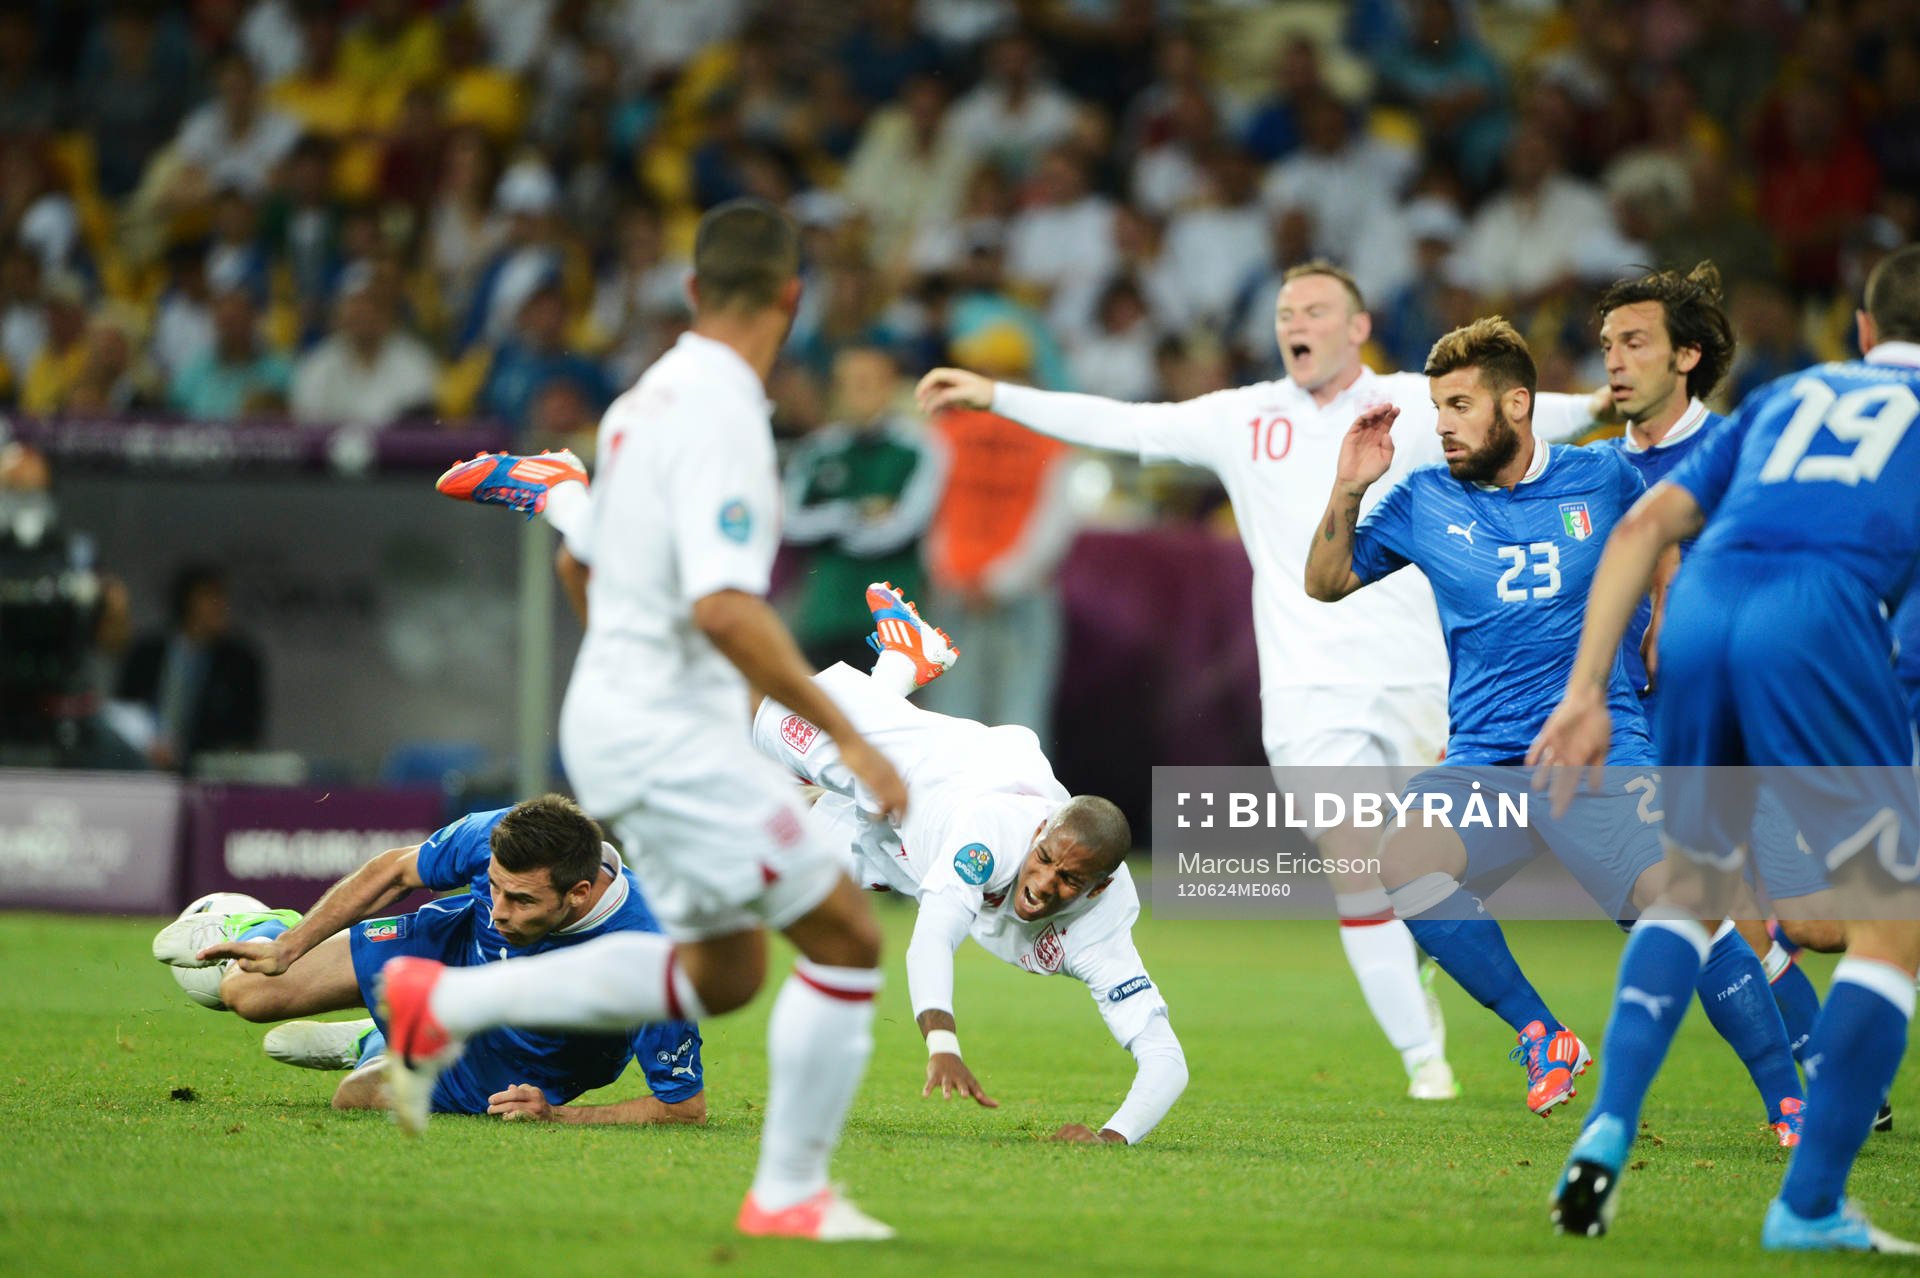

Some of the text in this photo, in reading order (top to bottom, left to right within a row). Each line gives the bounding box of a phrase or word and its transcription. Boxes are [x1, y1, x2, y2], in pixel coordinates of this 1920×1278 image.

[1248, 416, 1292, 462] 10
[1759, 376, 1919, 487] 19
[1496, 541, 1562, 602] 23
[1624, 773, 1664, 824] 2
[1717, 974, 1752, 1001] ITALIA
